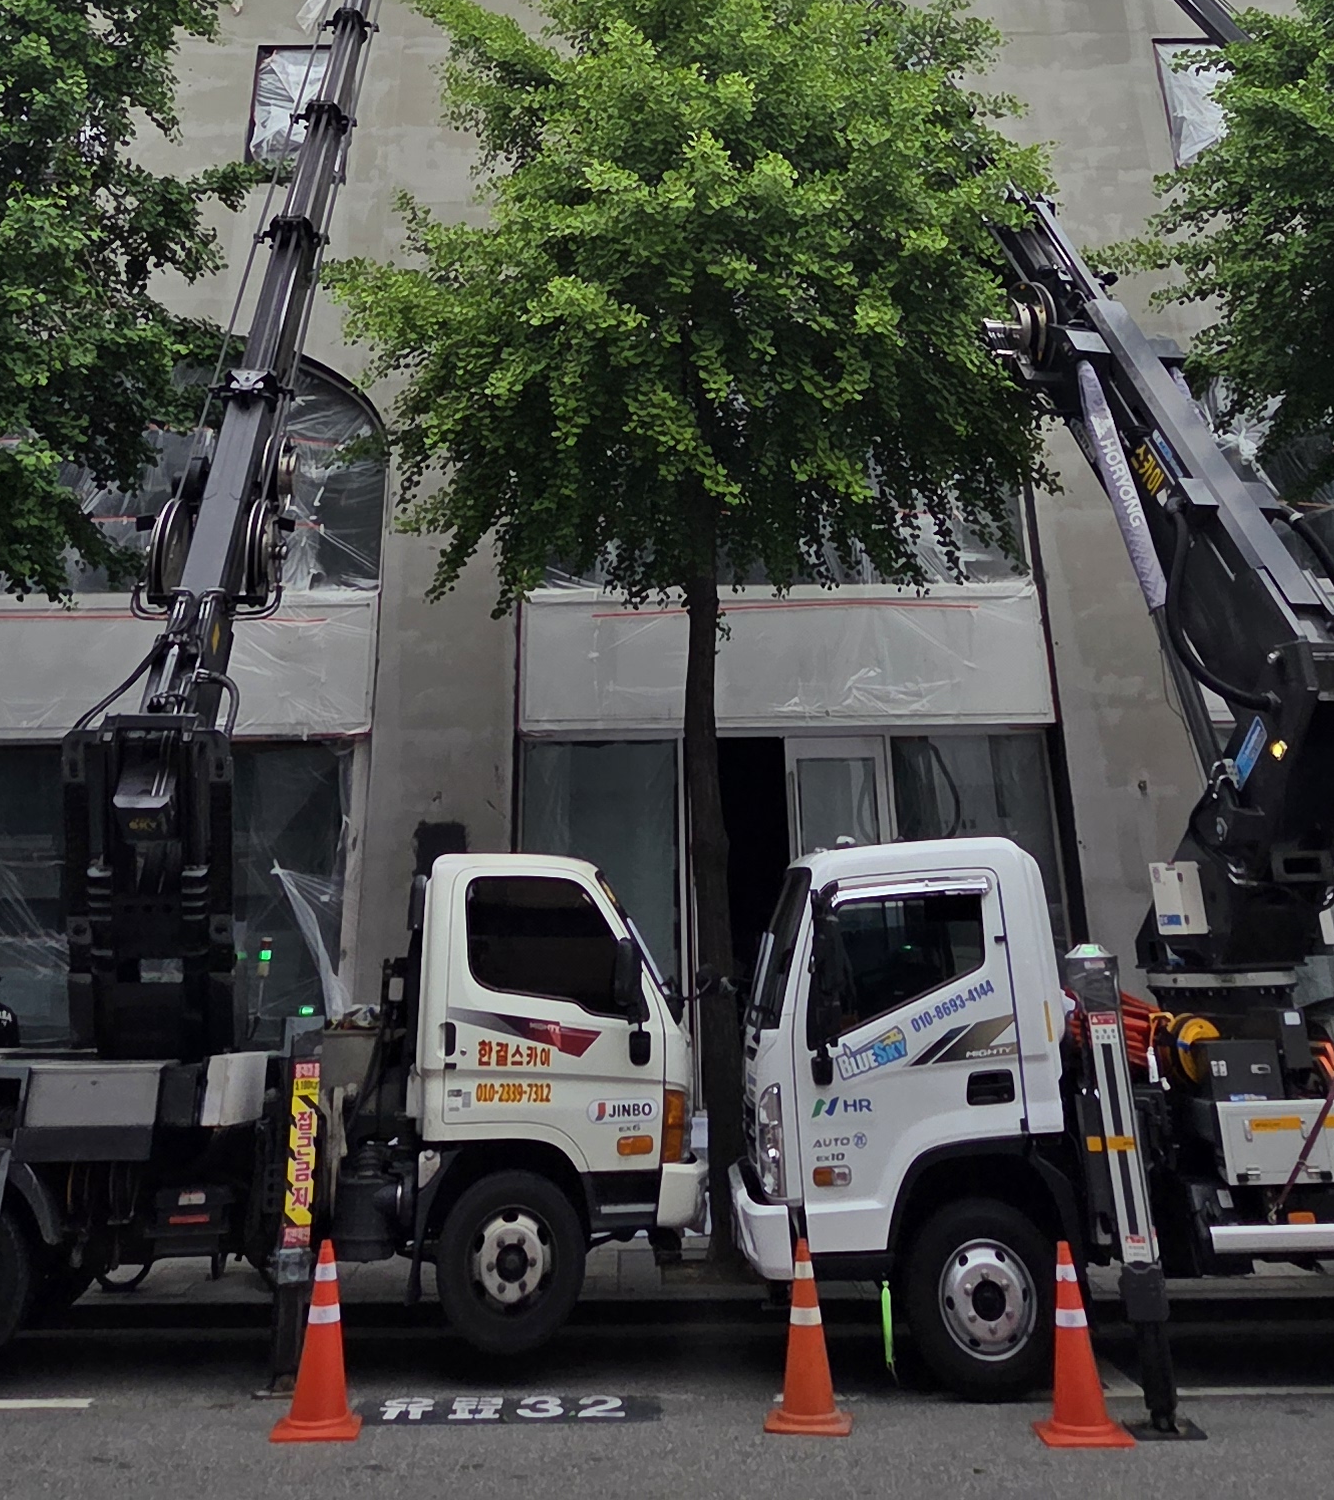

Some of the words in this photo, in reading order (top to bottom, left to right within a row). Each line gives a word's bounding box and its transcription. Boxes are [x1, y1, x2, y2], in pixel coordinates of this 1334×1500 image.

[1130, 444, 1165, 497] 스카이
[1100, 438, 1144, 528] HORYONG
[910, 979, 995, 1033] 010-8693-4144
[965, 1046, 1013, 1058] MIGHTY
[475, 1082, 552, 1103] 010-2339-7312
[608, 1102, 653, 1118] JINBO
[842, 1098, 873, 1113] HR
[812, 1136, 851, 1149] AUTO
[291, 1111, 313, 1208] 접근금지
